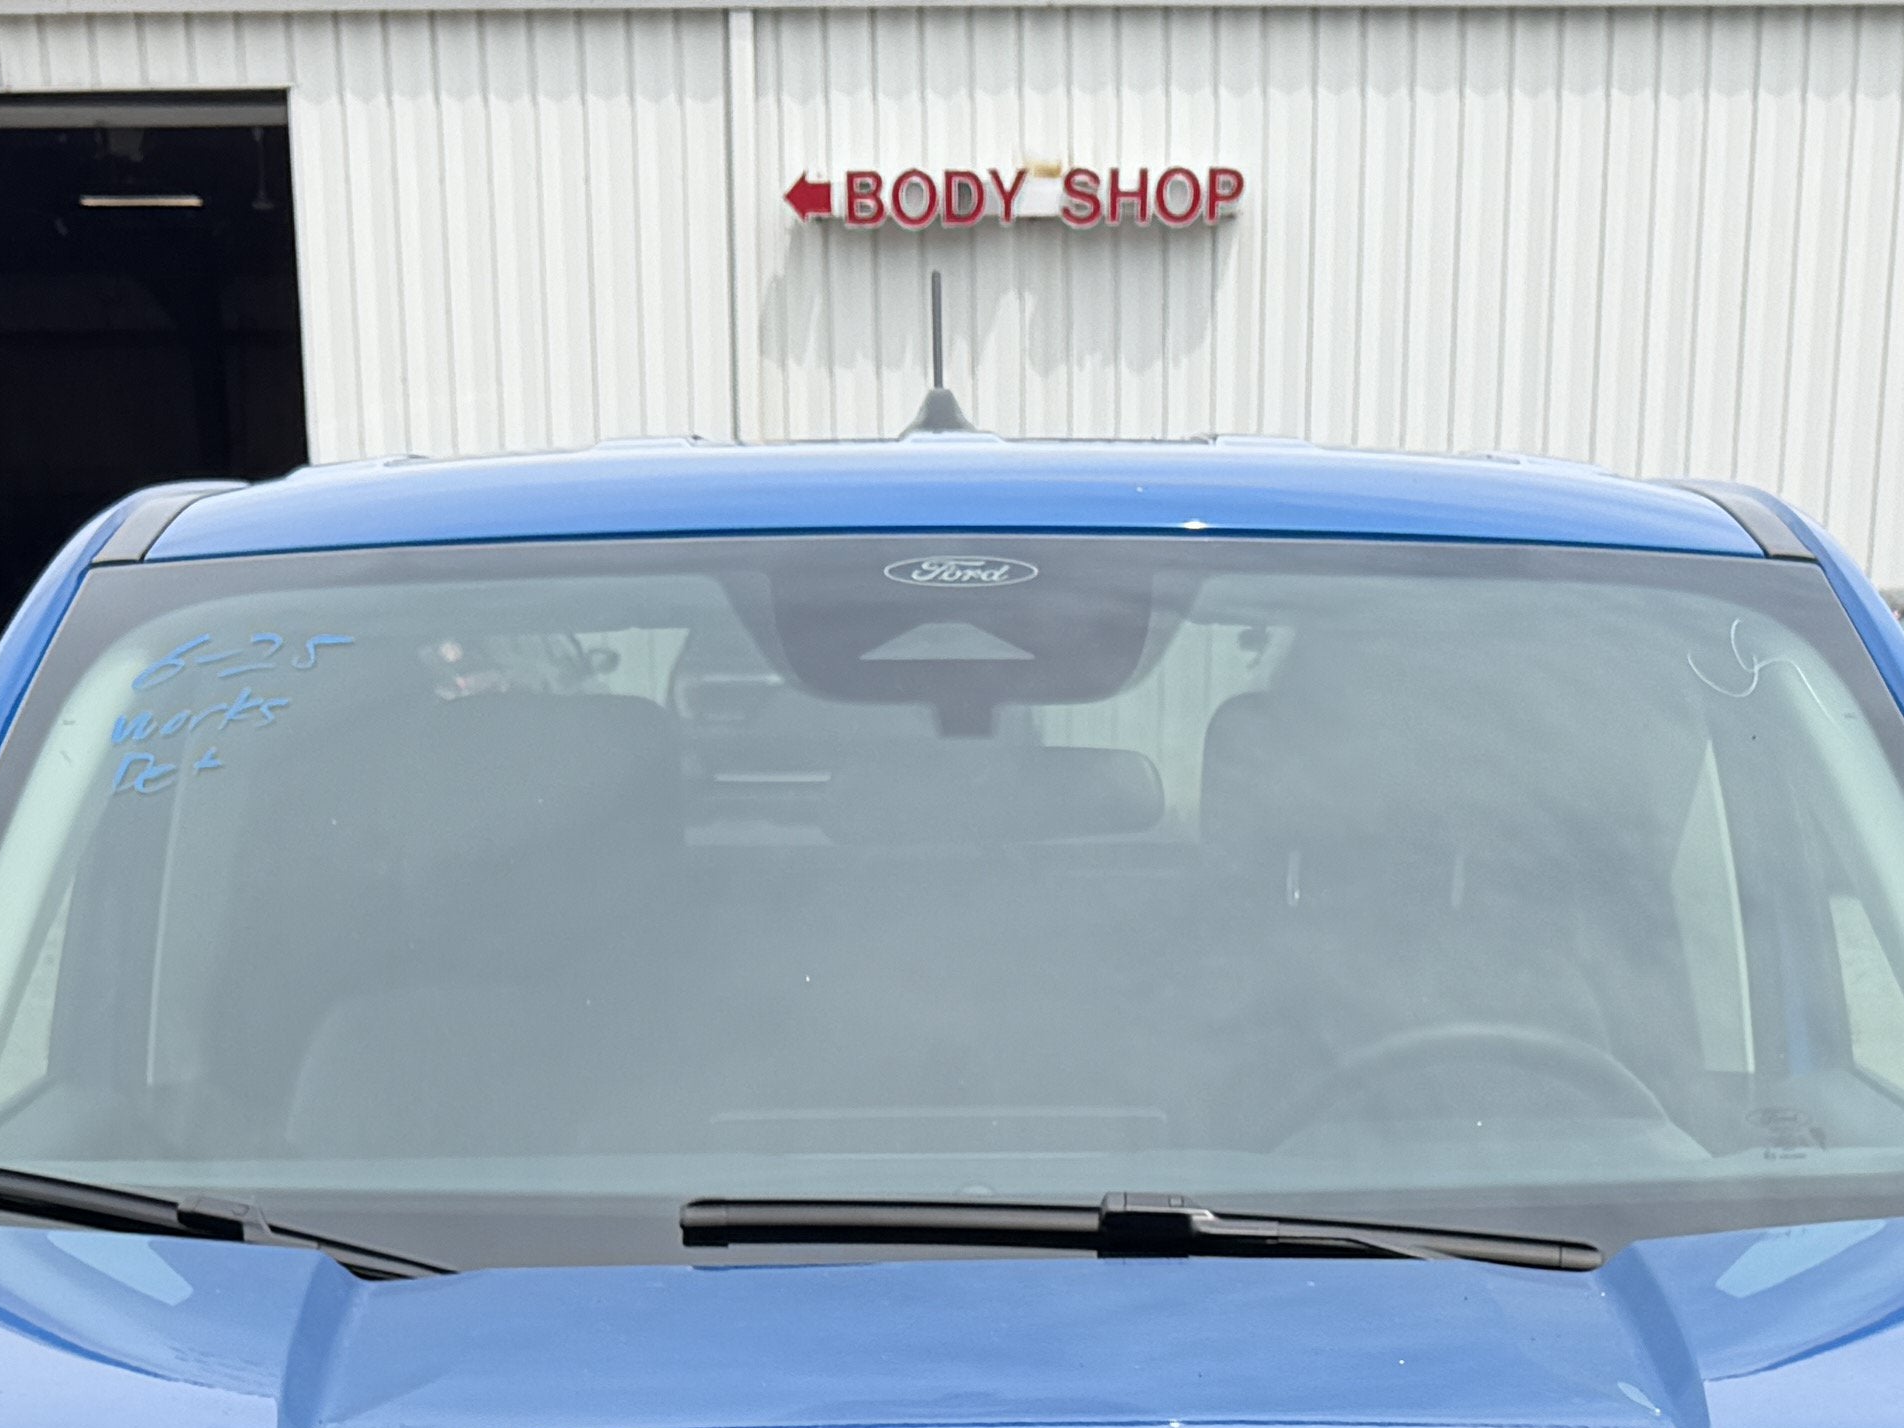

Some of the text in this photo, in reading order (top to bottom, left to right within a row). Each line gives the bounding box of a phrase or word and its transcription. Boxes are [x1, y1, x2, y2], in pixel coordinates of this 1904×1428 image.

[845, 165, 1245, 228] BODY SHOP
[911, 558, 1010, 583] Ford
